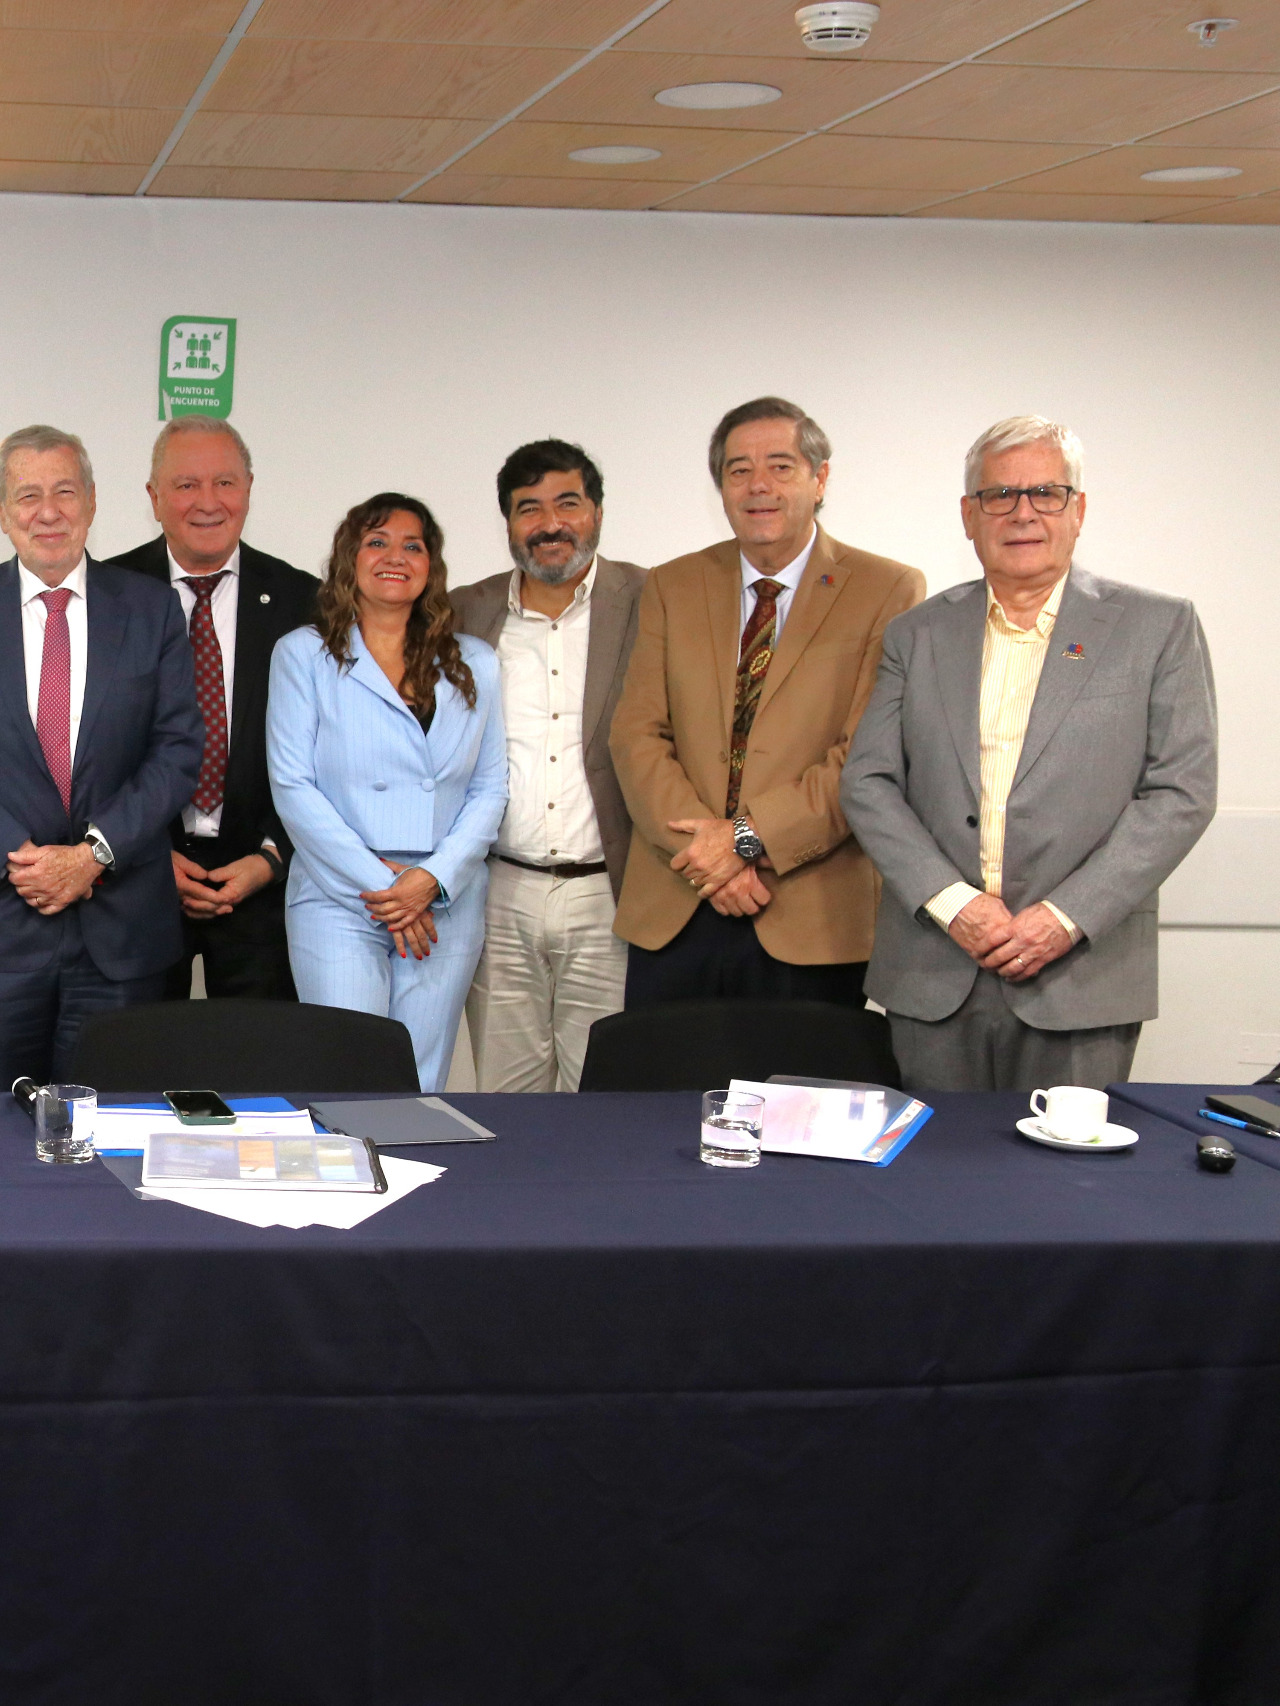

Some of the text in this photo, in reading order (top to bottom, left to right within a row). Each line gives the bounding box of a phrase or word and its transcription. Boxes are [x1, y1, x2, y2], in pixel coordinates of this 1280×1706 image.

[174, 386, 215, 396] PUNTO DE
[170, 397, 220, 407] ENCUENTRO
